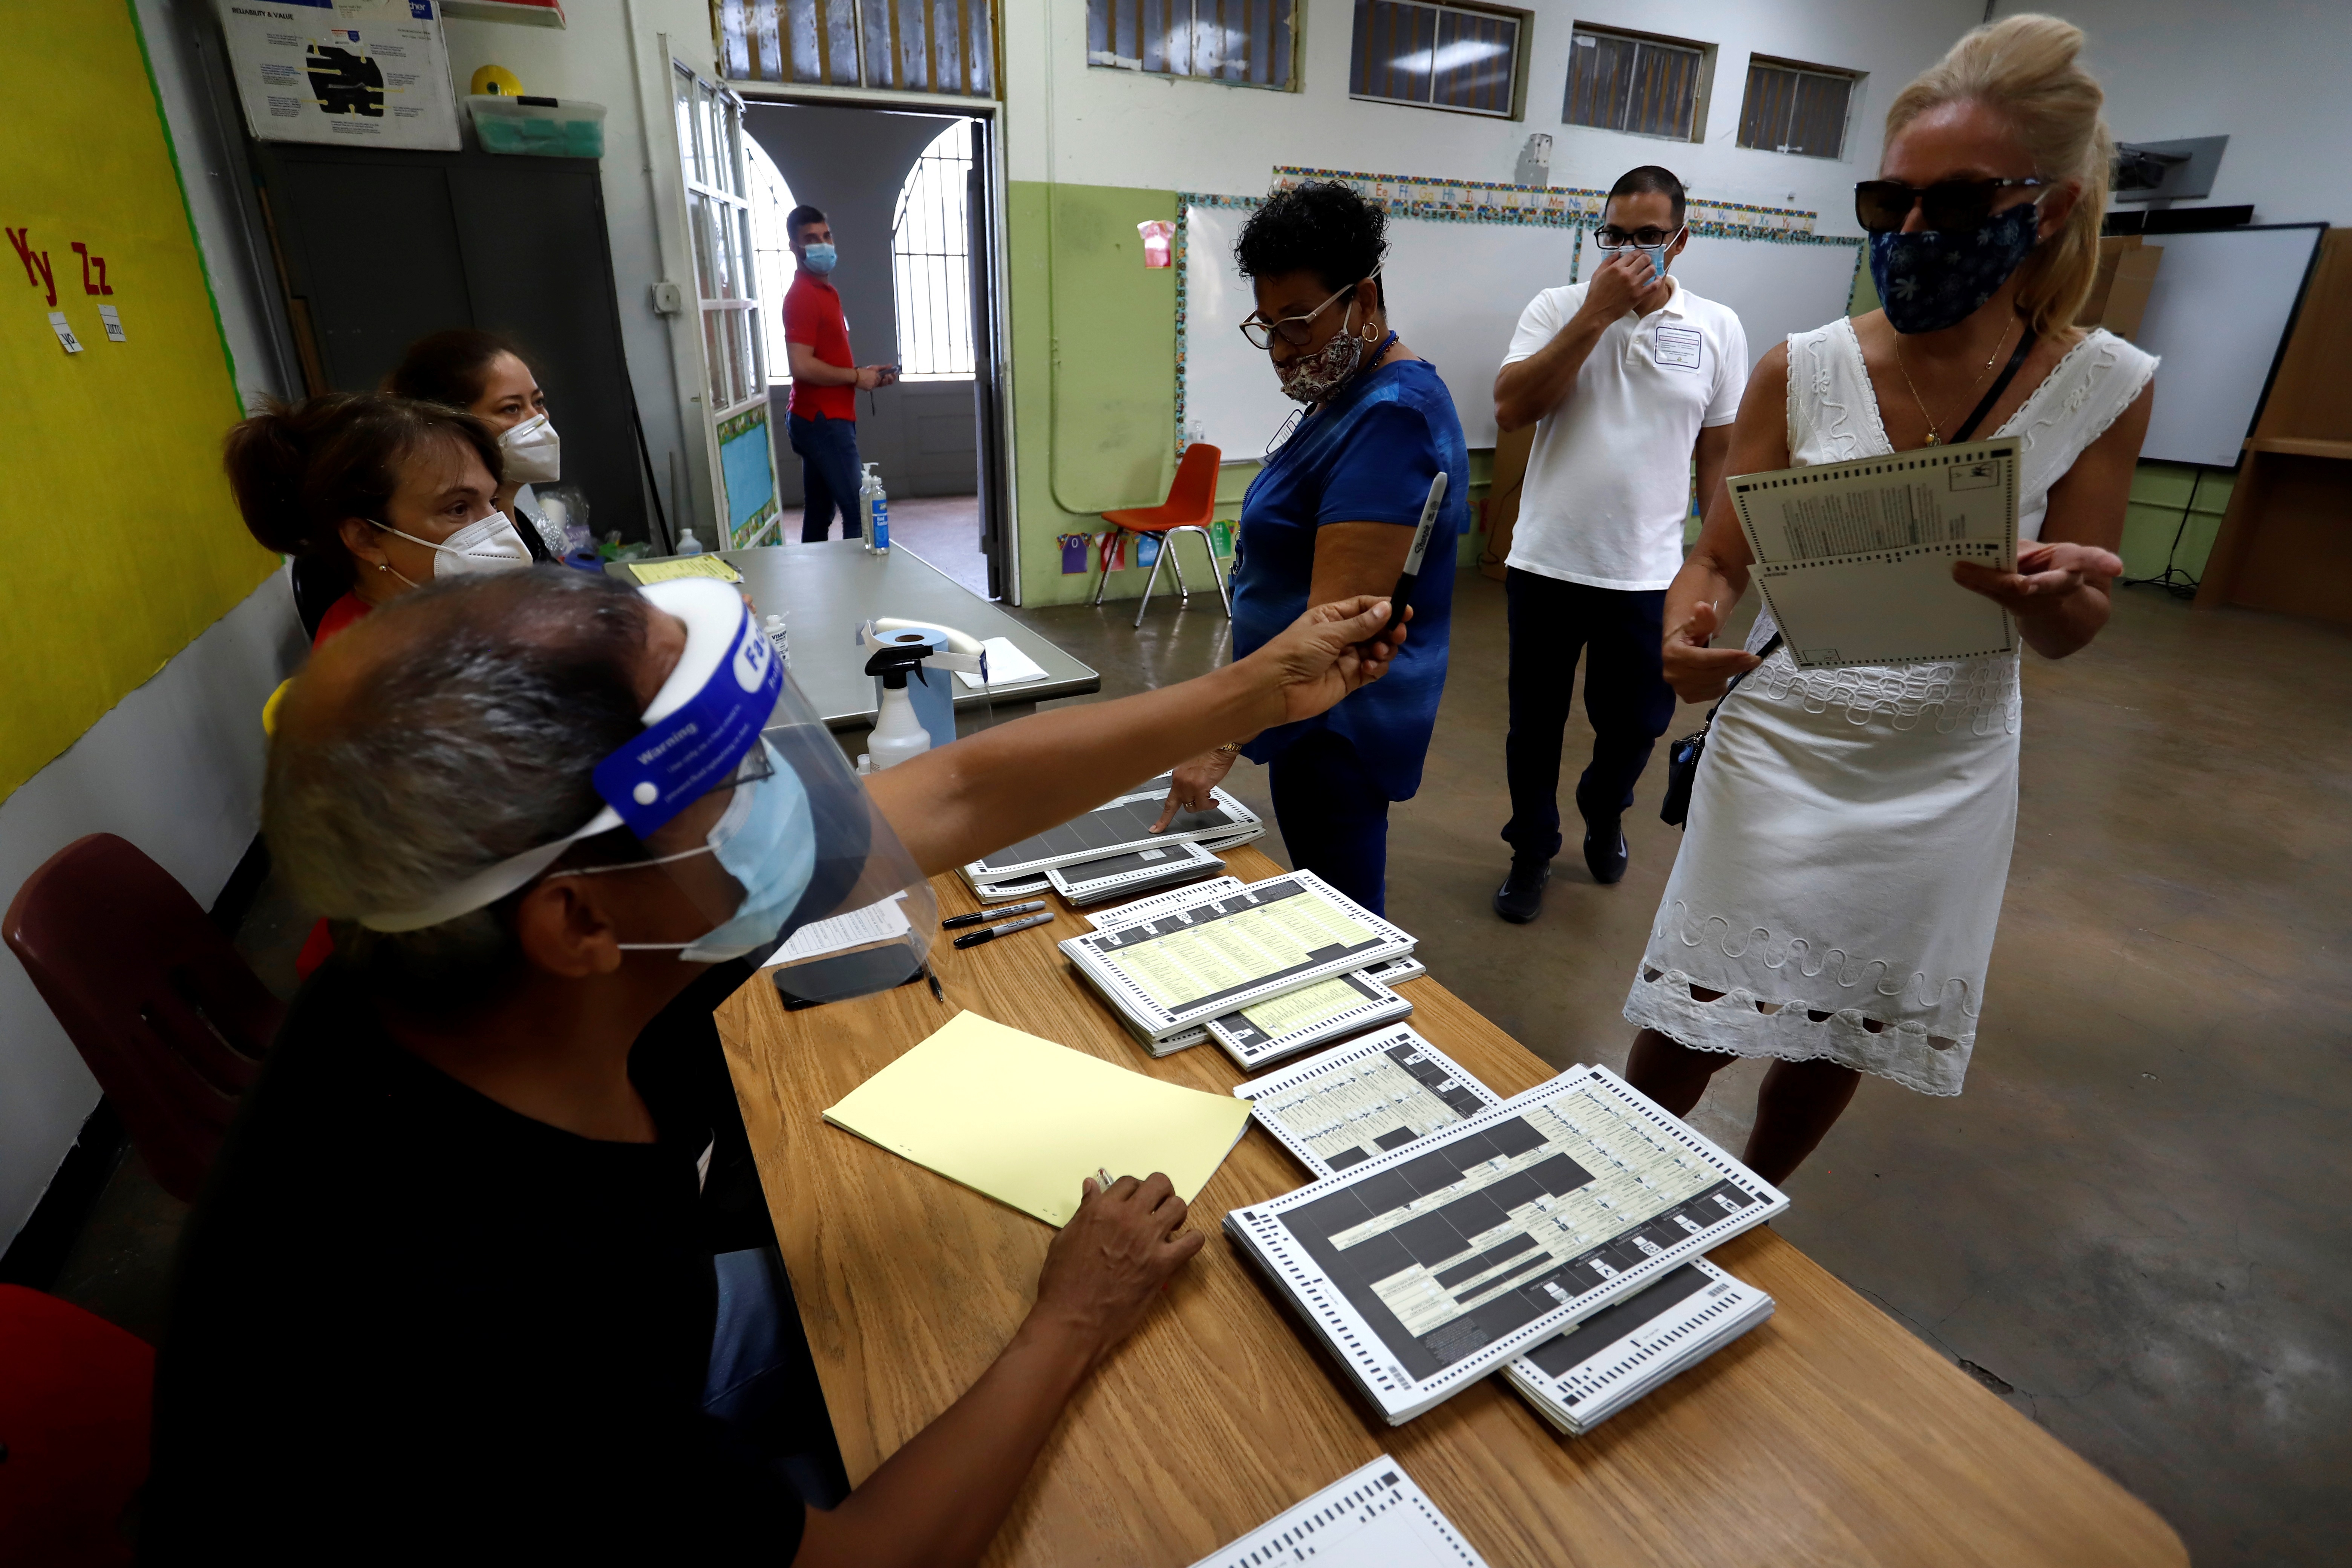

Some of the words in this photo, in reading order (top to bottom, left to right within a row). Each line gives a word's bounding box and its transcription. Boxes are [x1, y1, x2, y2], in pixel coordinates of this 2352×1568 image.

[232, 8, 265, 17] RELIABILITY
[1377, 184, 1388, 196] Ee
[1399, 185, 1409, 197] Ff
[1420, 187, 1433, 201] Gg
[1442, 188, 1455, 201] Hh
[1465, 190, 1474, 203] Ii
[1485, 191, 1493, 205] Jj
[1508, 193, 1519, 205] Kk
[1549, 196, 1564, 208] Mm
[1568, 197, 1581, 208] Nn
[1587, 198, 1600, 210] Oo
[1694, 207, 1703, 219] Uu
[1717, 210, 1726, 220] Vv
[1737, 212, 1751, 223] Ww
[1759, 215, 1769, 225] Xx
[1782, 217, 1790, 229] Yy
[1804, 219, 1812, 230] Zz
[5, 227, 57, 307] Yy
[71, 242, 114, 295] Zz
[1071, 538, 1078, 548] 0
[1415, 525, 1432, 557] Sharpie
[637, 721, 699, 765] Warning
